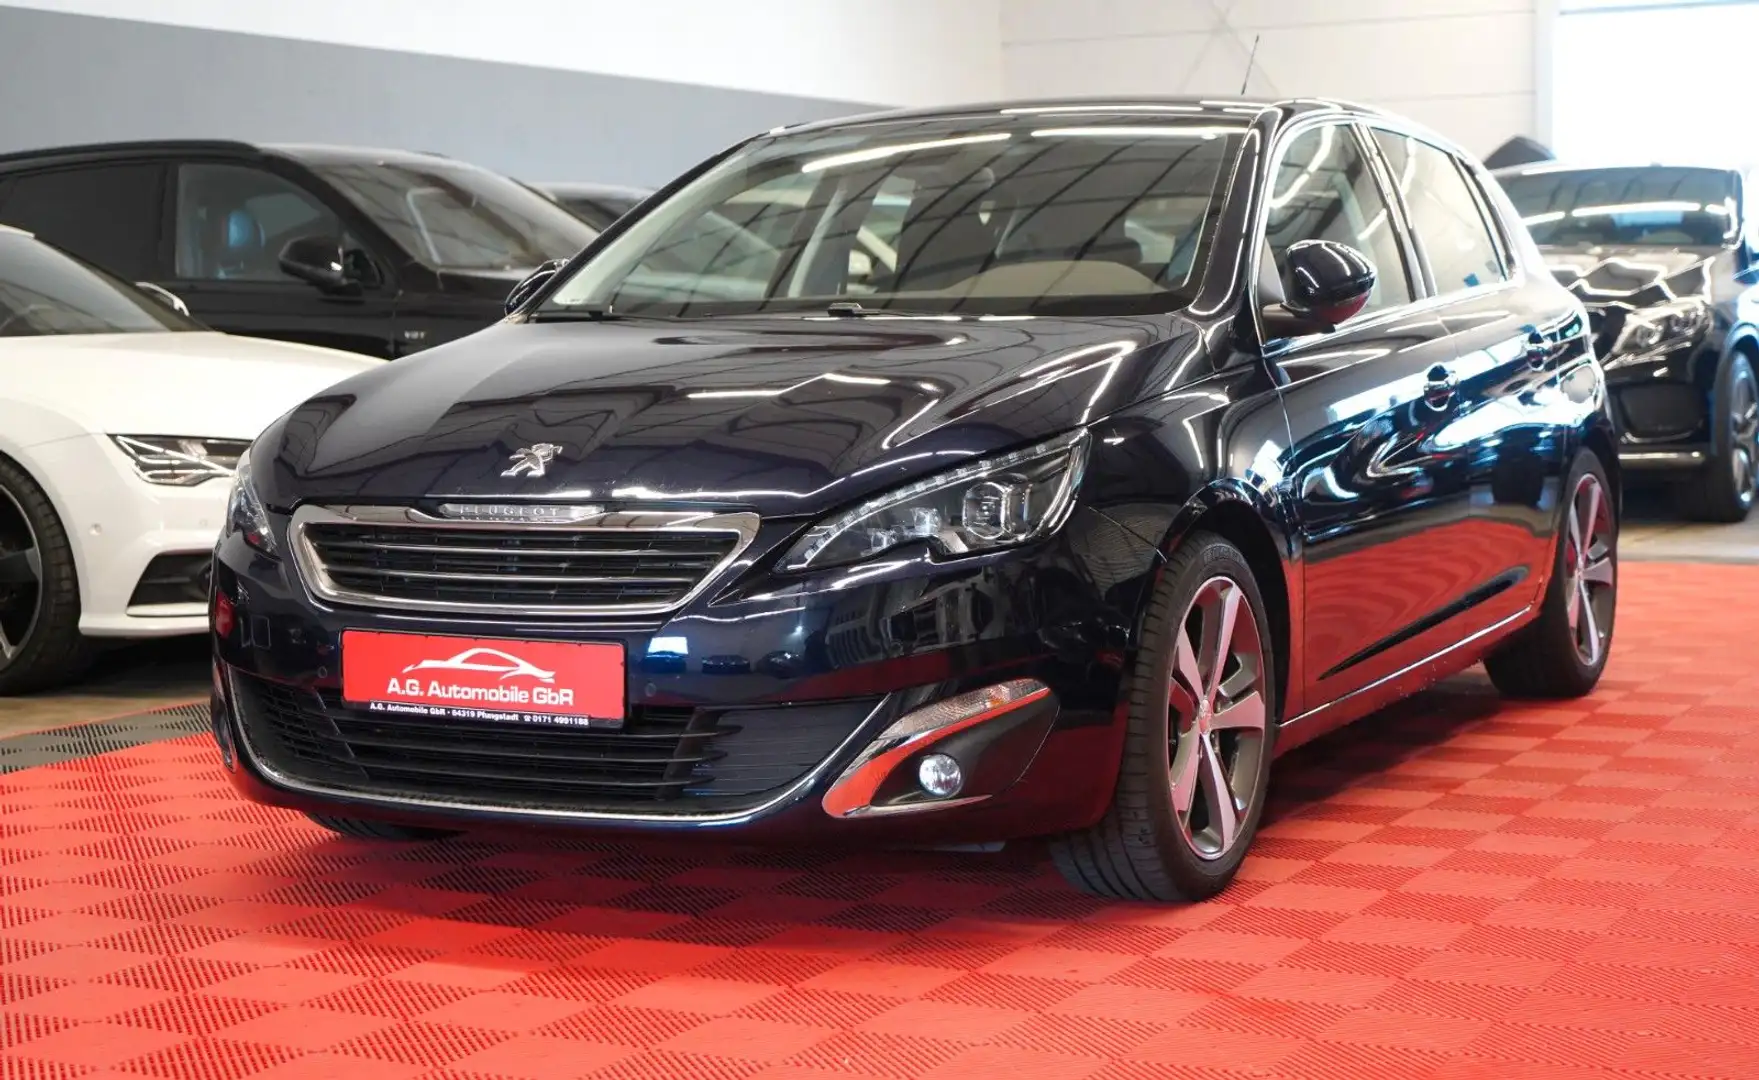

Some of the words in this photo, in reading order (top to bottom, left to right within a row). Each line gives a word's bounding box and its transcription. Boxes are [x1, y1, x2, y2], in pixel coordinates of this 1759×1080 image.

[460, 505, 559, 517] PEUGEOT
[387, 678, 424, 697] A.G.
[427, 681, 529, 704] Automobile
[533, 688, 574, 706] GbR
[369, 702, 385, 711] A.G.
[387, 704, 428, 714] Automobile
[430, 708, 446, 716] GbR
[533, 714, 551, 723] 0171
